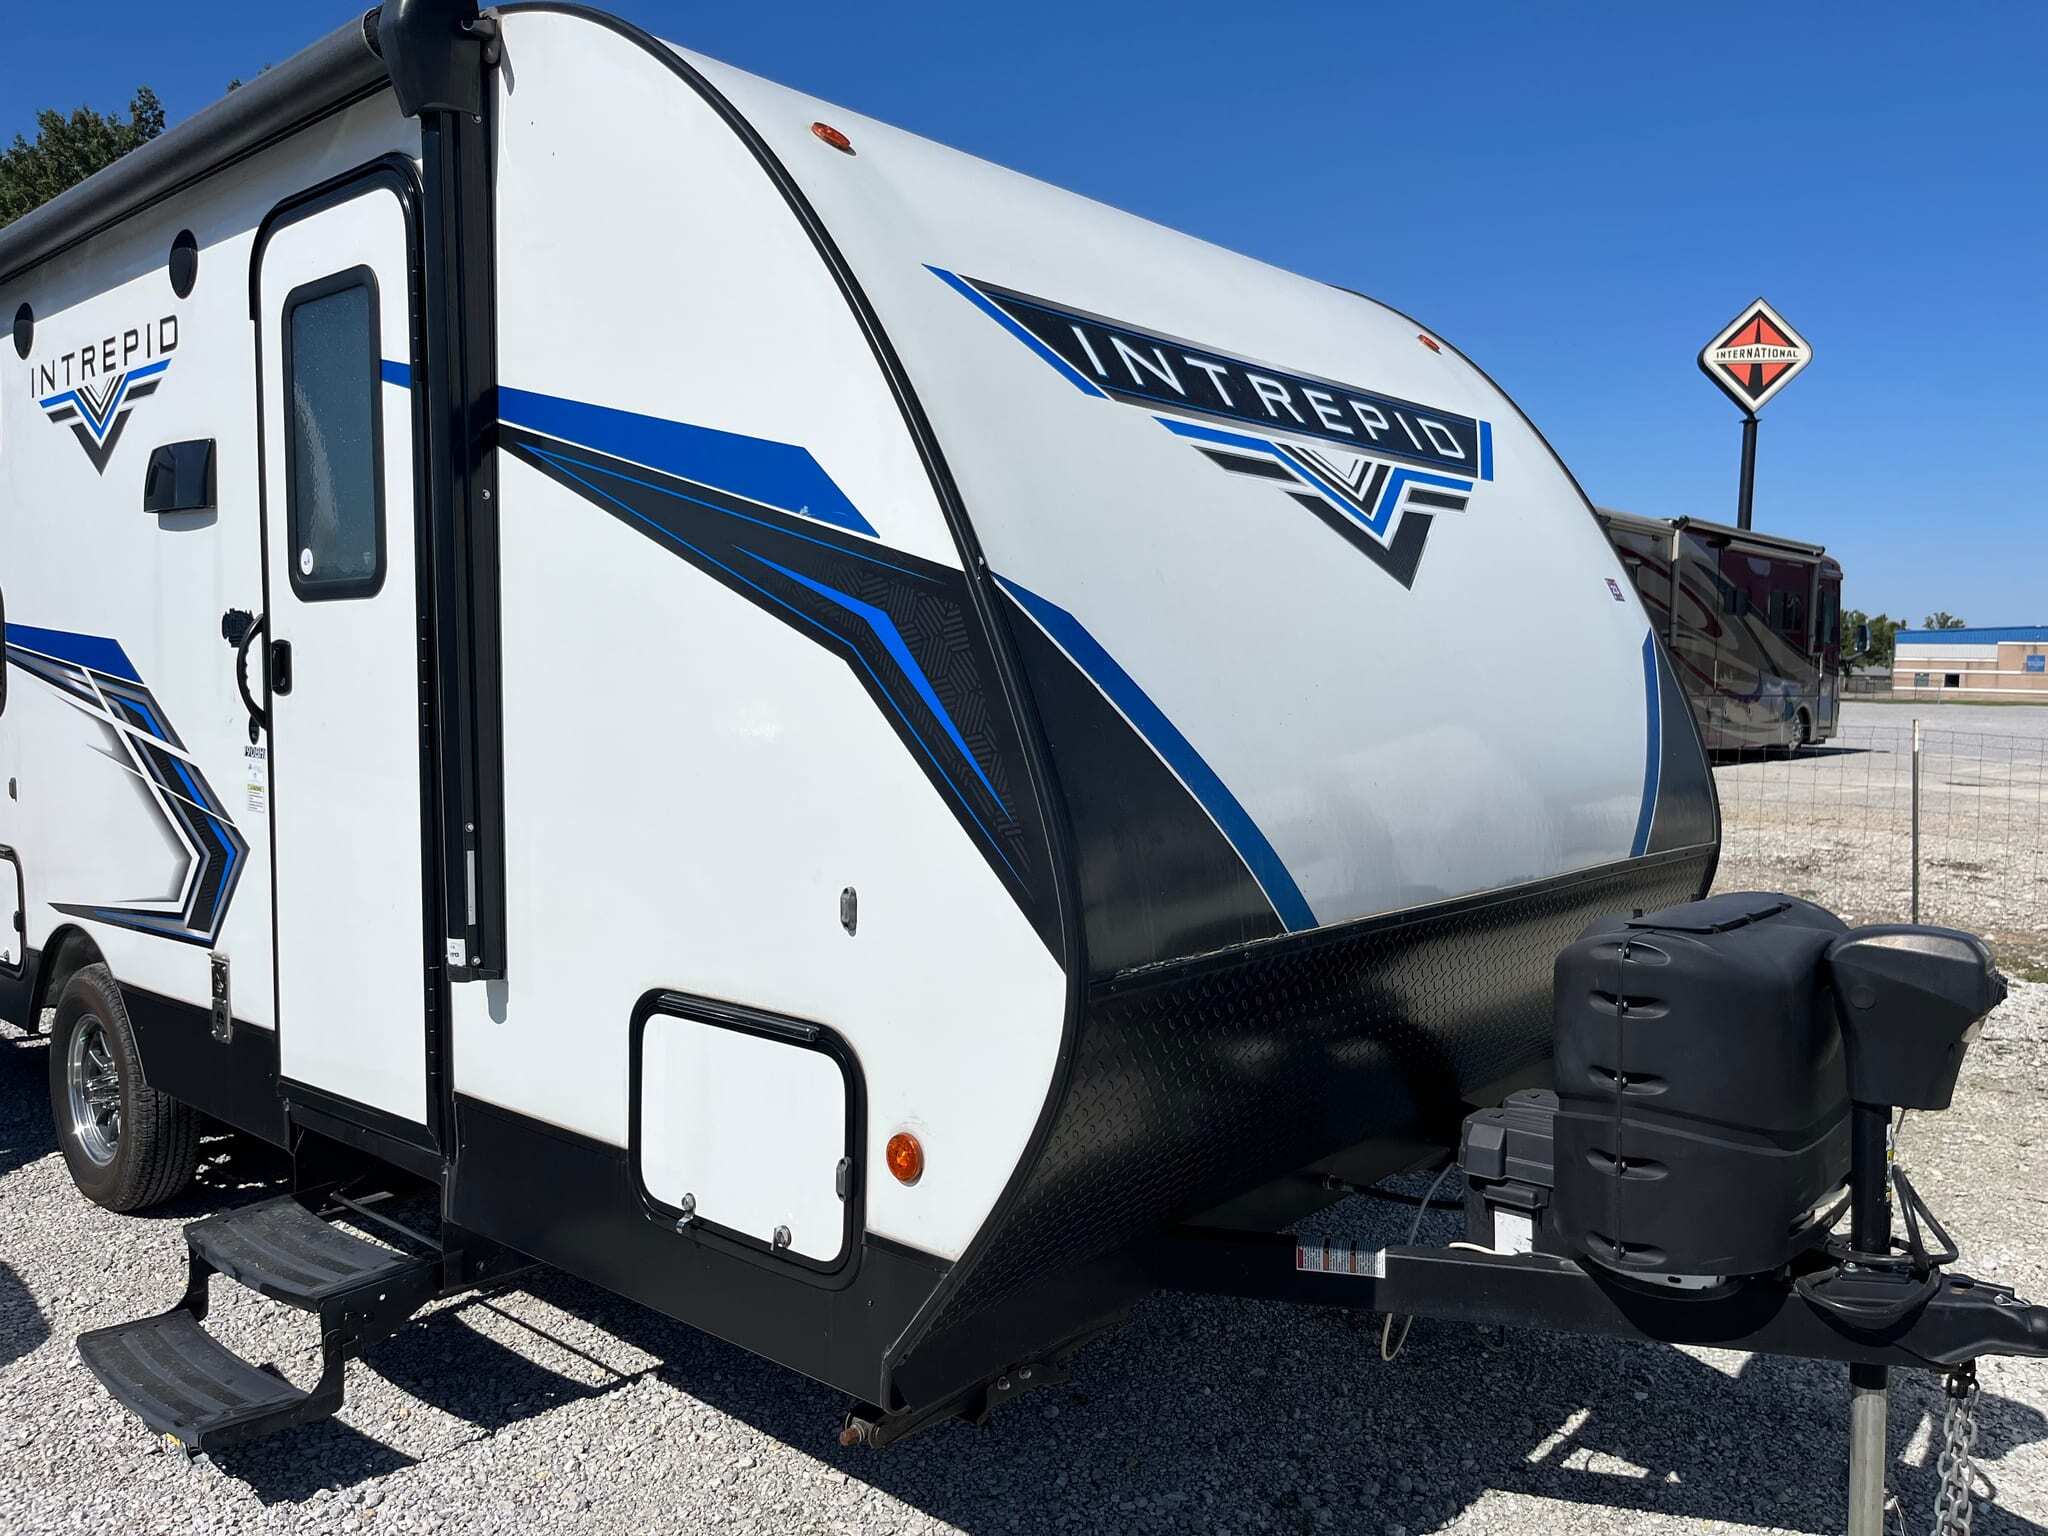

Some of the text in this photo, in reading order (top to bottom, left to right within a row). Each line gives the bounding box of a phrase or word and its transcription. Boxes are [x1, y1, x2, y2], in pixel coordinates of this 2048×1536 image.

[31, 315, 179, 398] INTREPID
[1071, 326, 1466, 460] INTREPID
[1716, 346, 1799, 360] INTERNATIONAL
